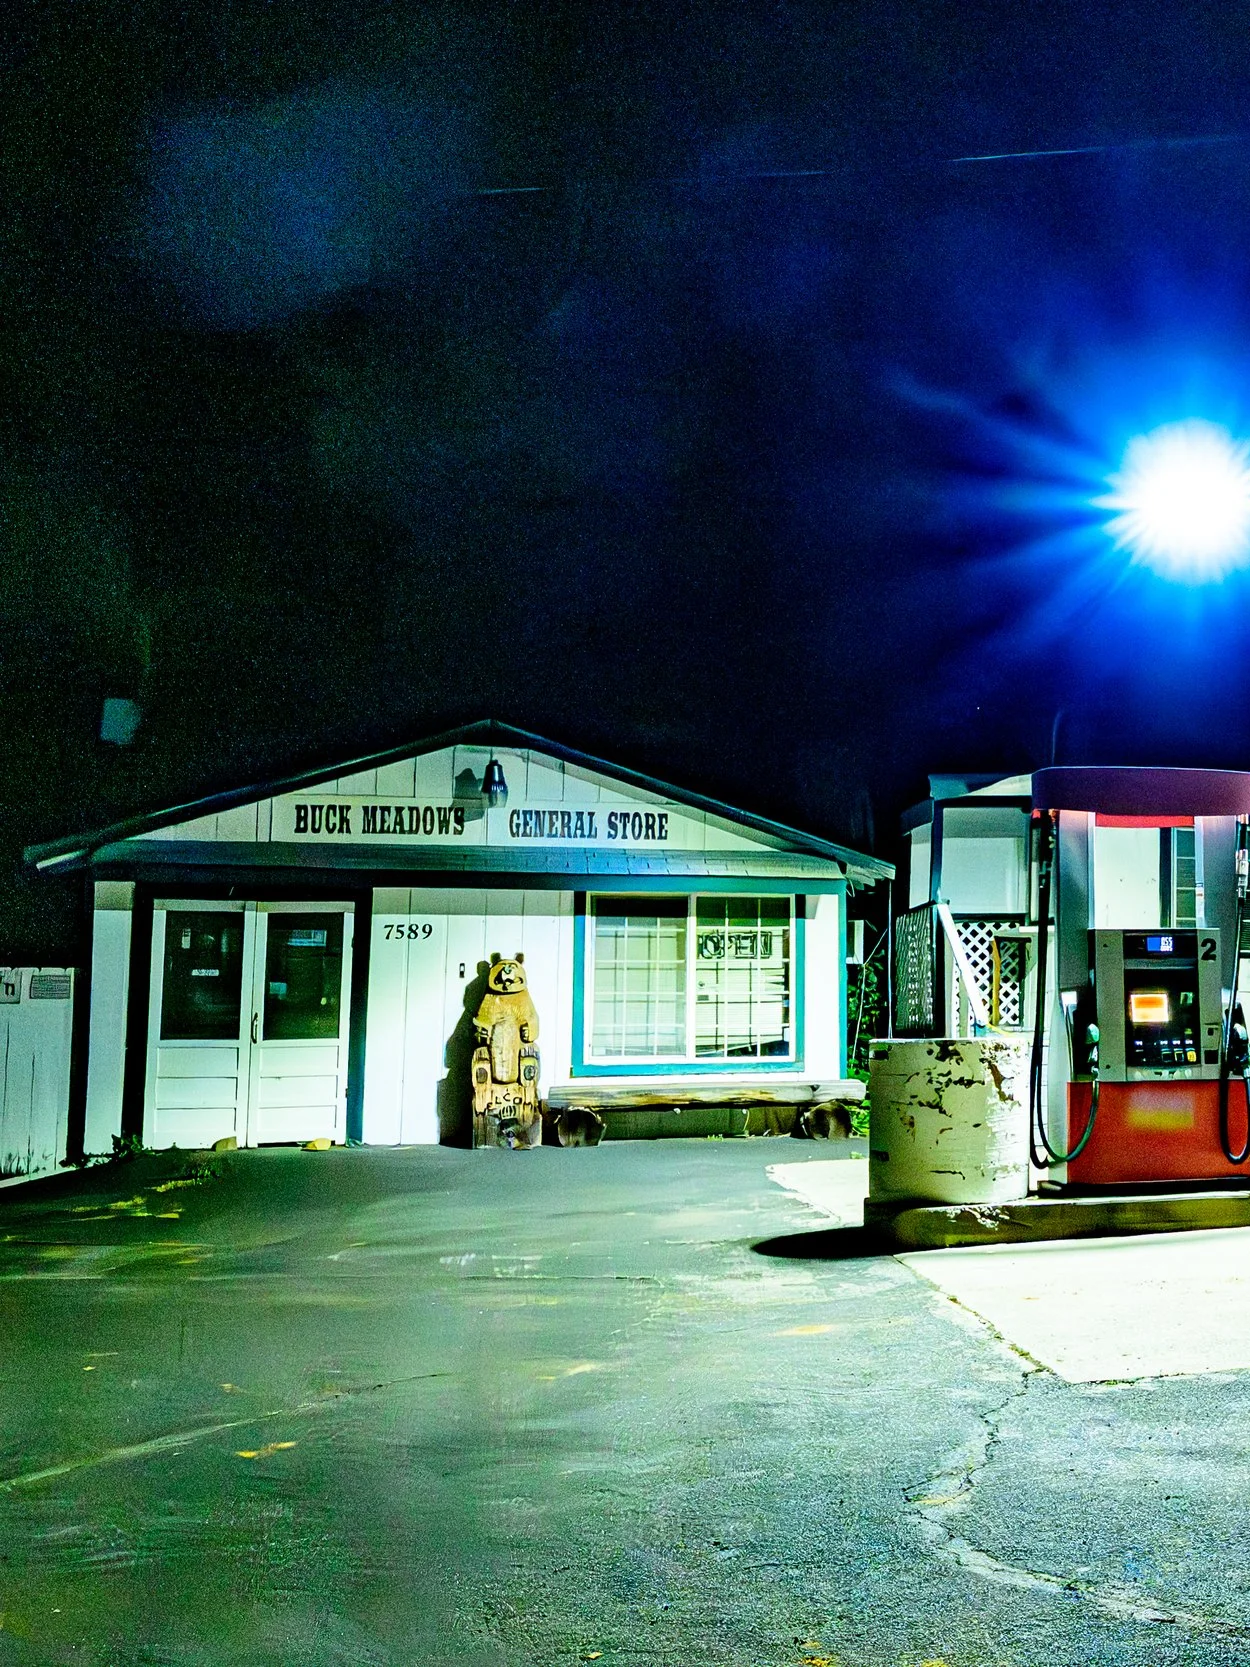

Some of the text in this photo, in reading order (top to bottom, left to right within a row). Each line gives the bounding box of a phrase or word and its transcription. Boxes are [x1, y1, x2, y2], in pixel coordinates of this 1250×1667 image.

[295, 804, 466, 836] BUCK MEADOWS
[509, 809, 669, 840] GENERAL STORE
[383, 923, 433, 940] 7589
[1201, 938, 1217, 960] 2
